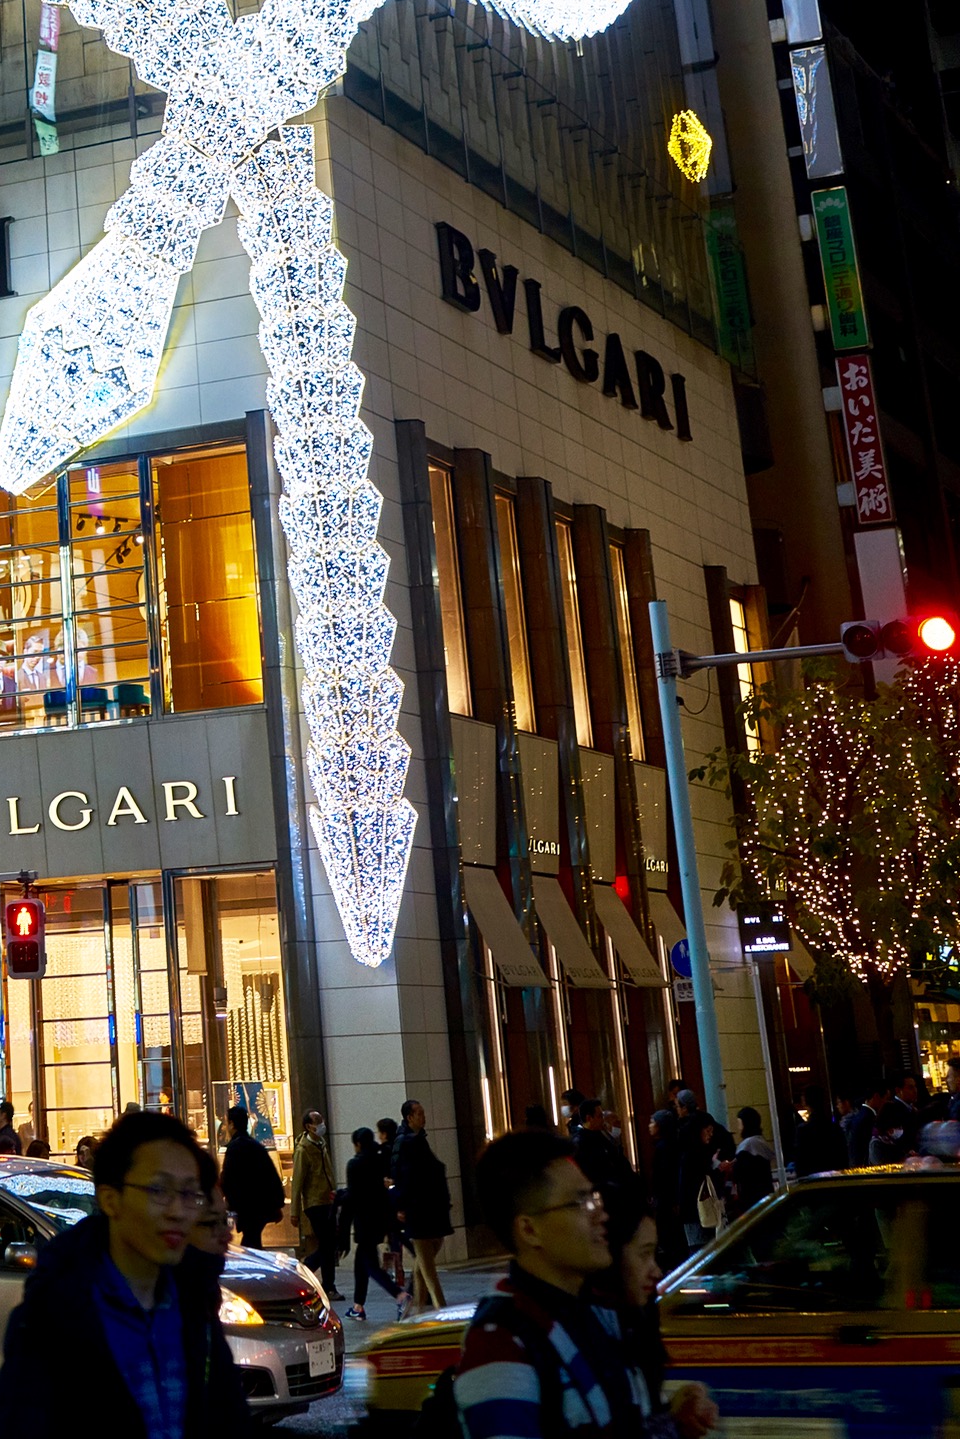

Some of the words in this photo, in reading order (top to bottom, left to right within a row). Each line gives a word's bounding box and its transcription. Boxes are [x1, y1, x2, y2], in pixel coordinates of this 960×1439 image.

[434, 221, 693, 442] BVLGARI
[842, 362, 888, 517] おいだ美術
